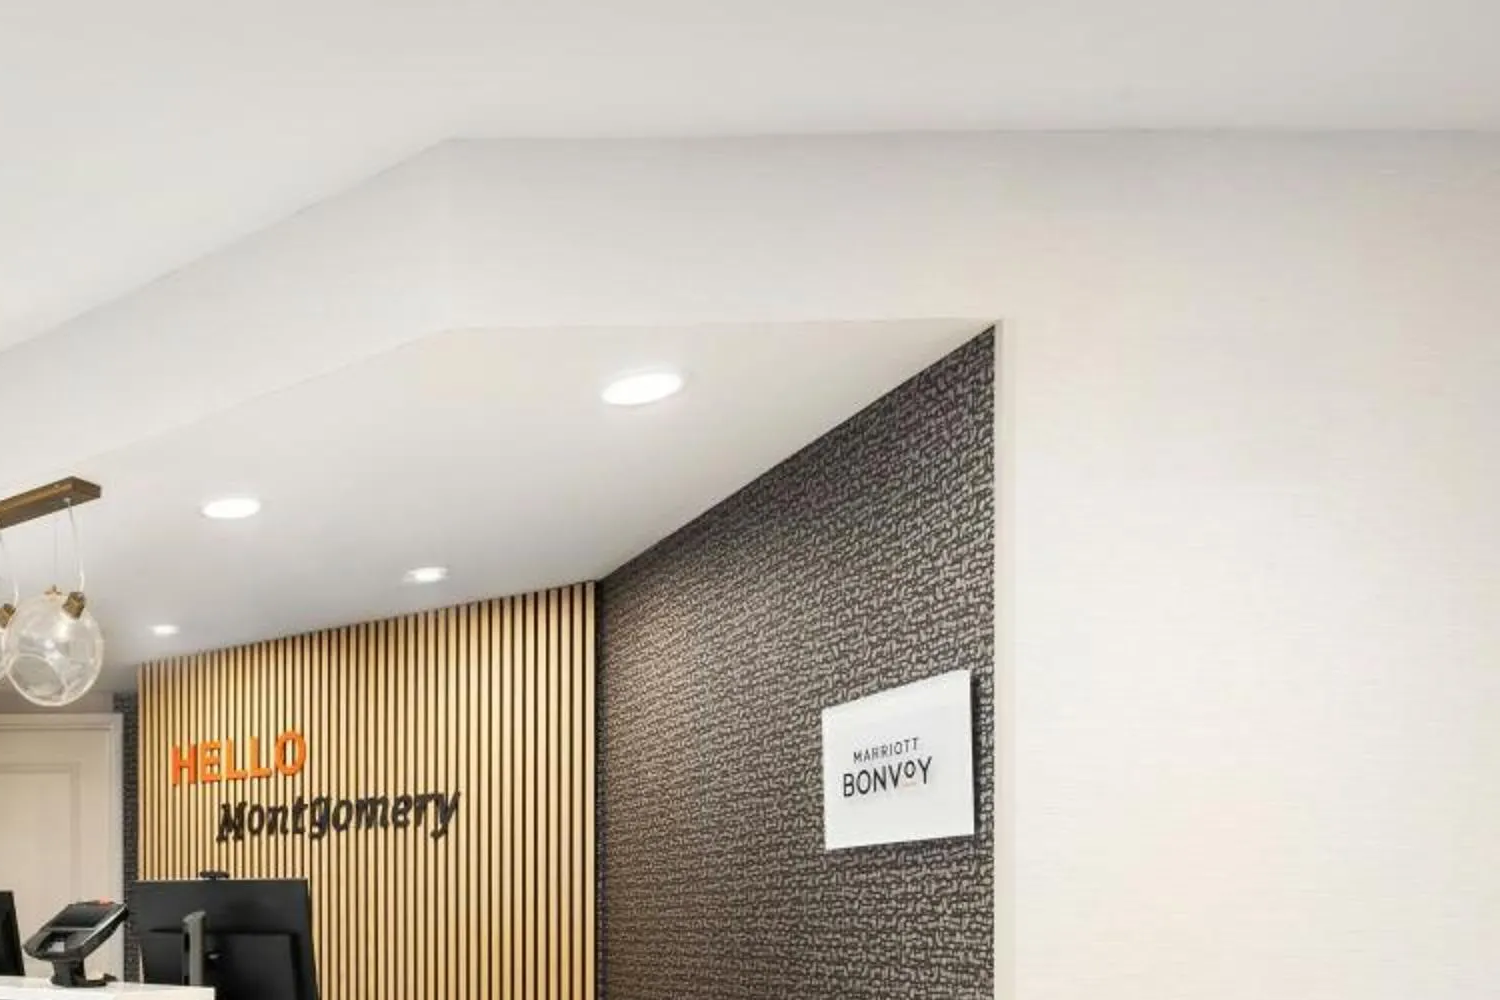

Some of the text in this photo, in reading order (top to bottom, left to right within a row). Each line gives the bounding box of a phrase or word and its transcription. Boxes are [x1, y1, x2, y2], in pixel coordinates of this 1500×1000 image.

[171, 730, 307, 786] HELLO
[853, 737, 918, 764] MARRIOTT
[216, 791, 461, 844] Montgomery
